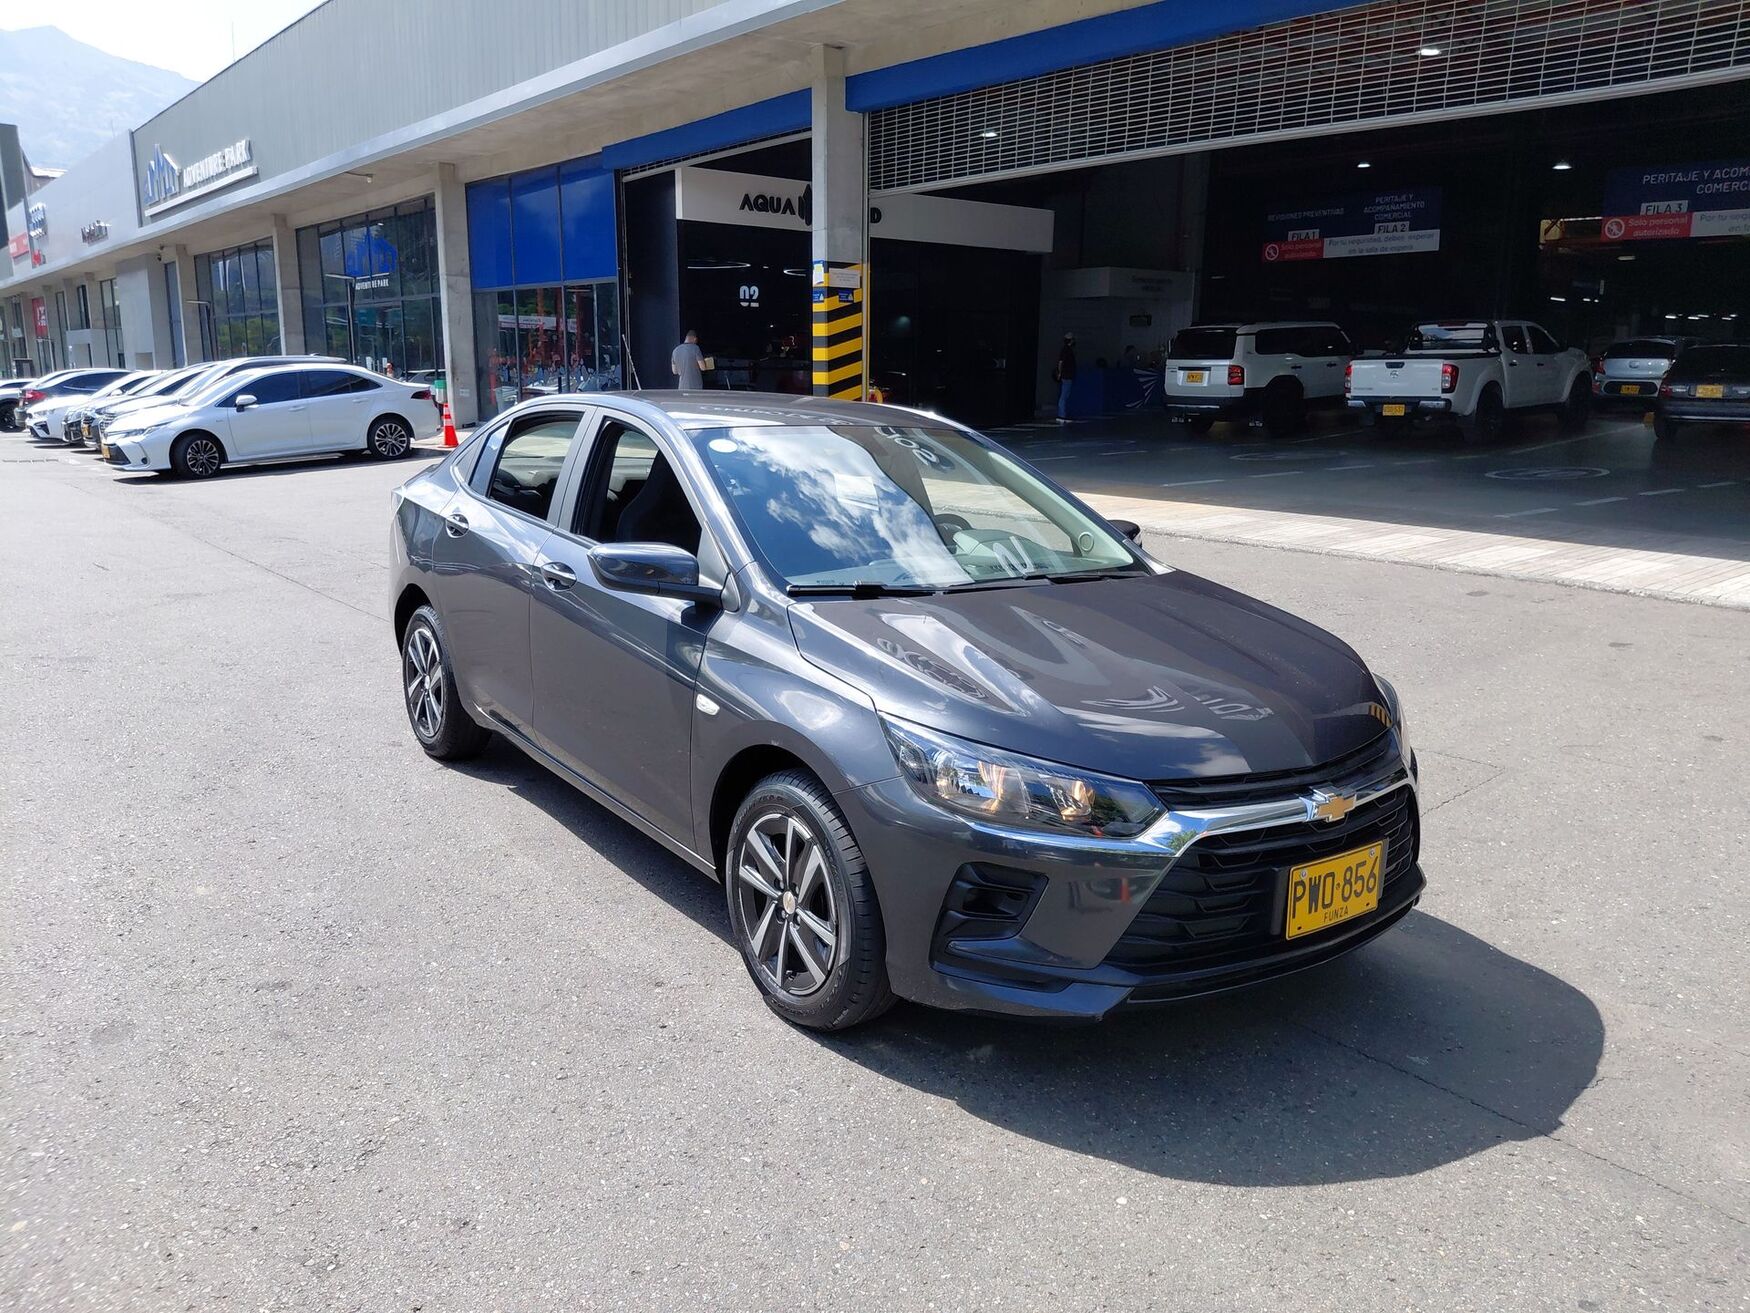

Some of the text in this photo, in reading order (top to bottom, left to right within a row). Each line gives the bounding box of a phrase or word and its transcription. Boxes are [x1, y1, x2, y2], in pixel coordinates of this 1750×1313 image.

[1643, 166, 1750, 185] PERITAJE Y ACOM
[739, 193, 796, 216] AQUA
[1645, 204, 1672, 216] FILA
[1377, 223, 1407, 234] FILA 2
[1628, 215, 1688, 228] Solo personal
[739, 285, 760, 308] 02
[1323, 905, 1349, 922] FUNZA
